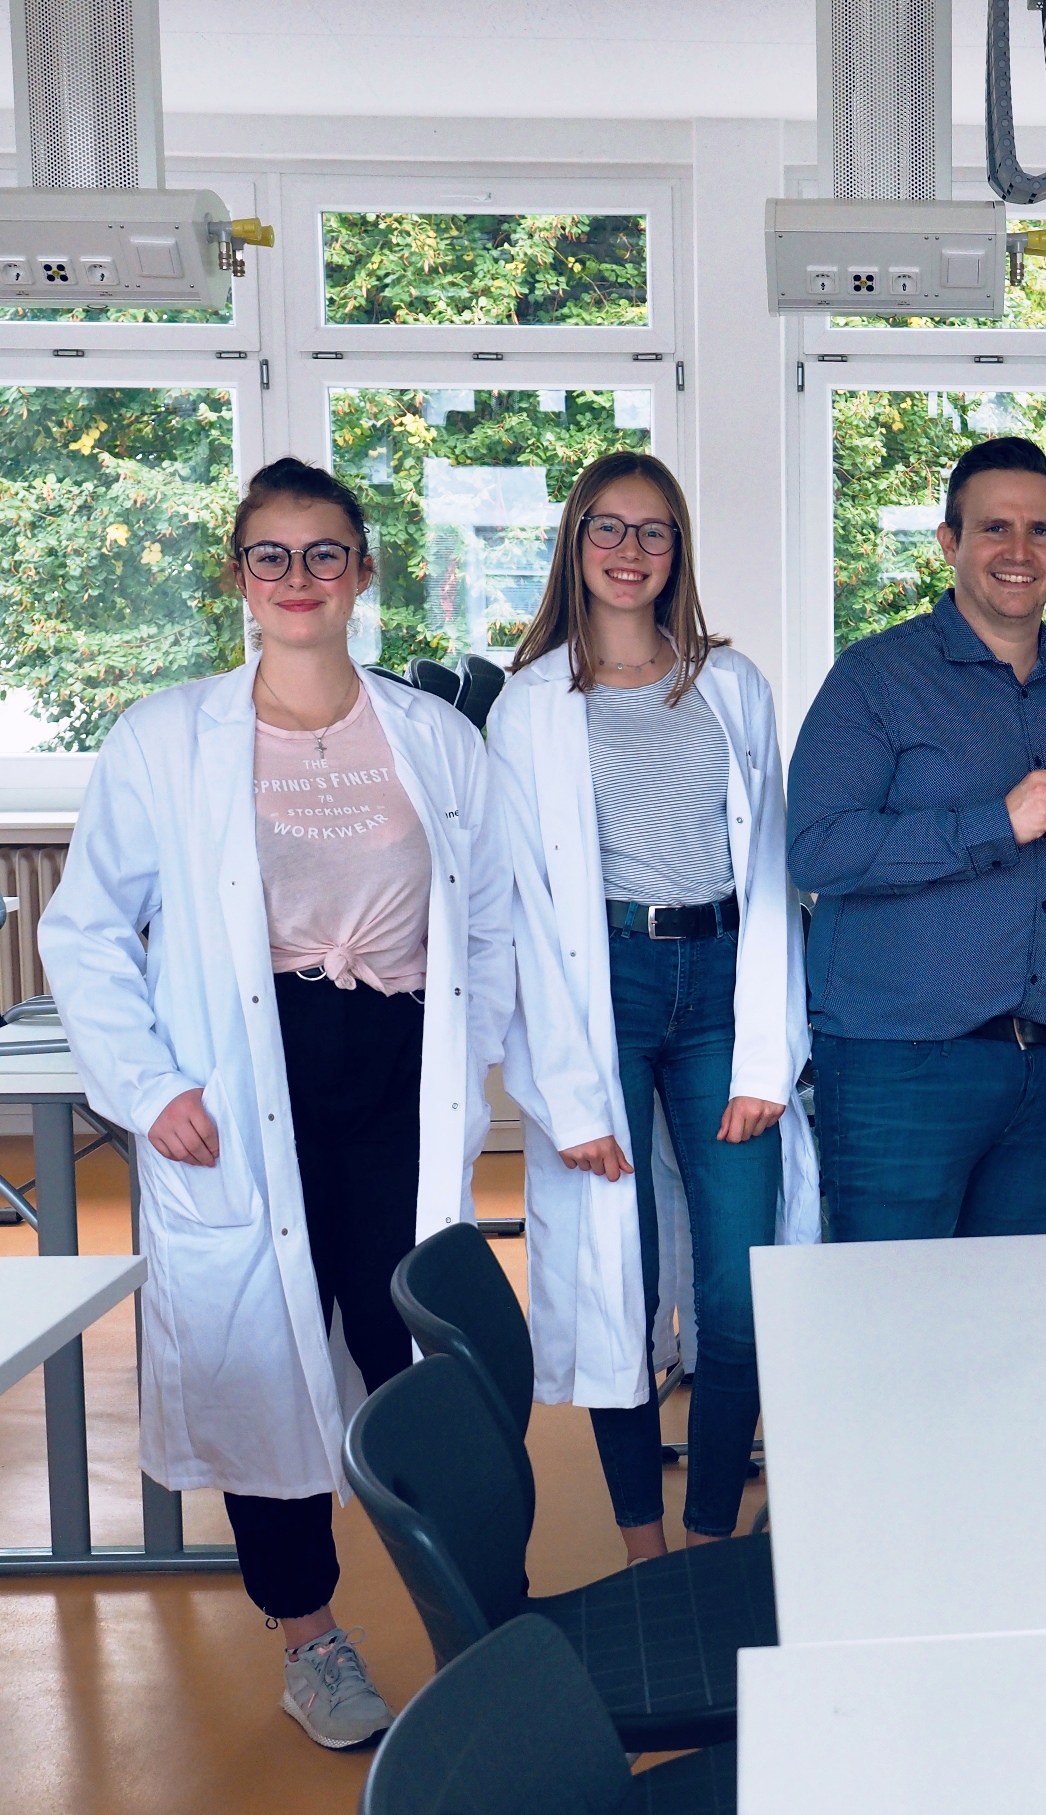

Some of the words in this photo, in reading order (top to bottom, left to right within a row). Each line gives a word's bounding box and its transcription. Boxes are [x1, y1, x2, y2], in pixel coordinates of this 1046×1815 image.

[303, 758, 329, 770] THE
[329, 767, 390, 788] FINEST
[317, 794, 334, 804] 78
[287, 804, 371, 817] STOCKHOLM
[273, 813, 389, 840] WORKWEAR
